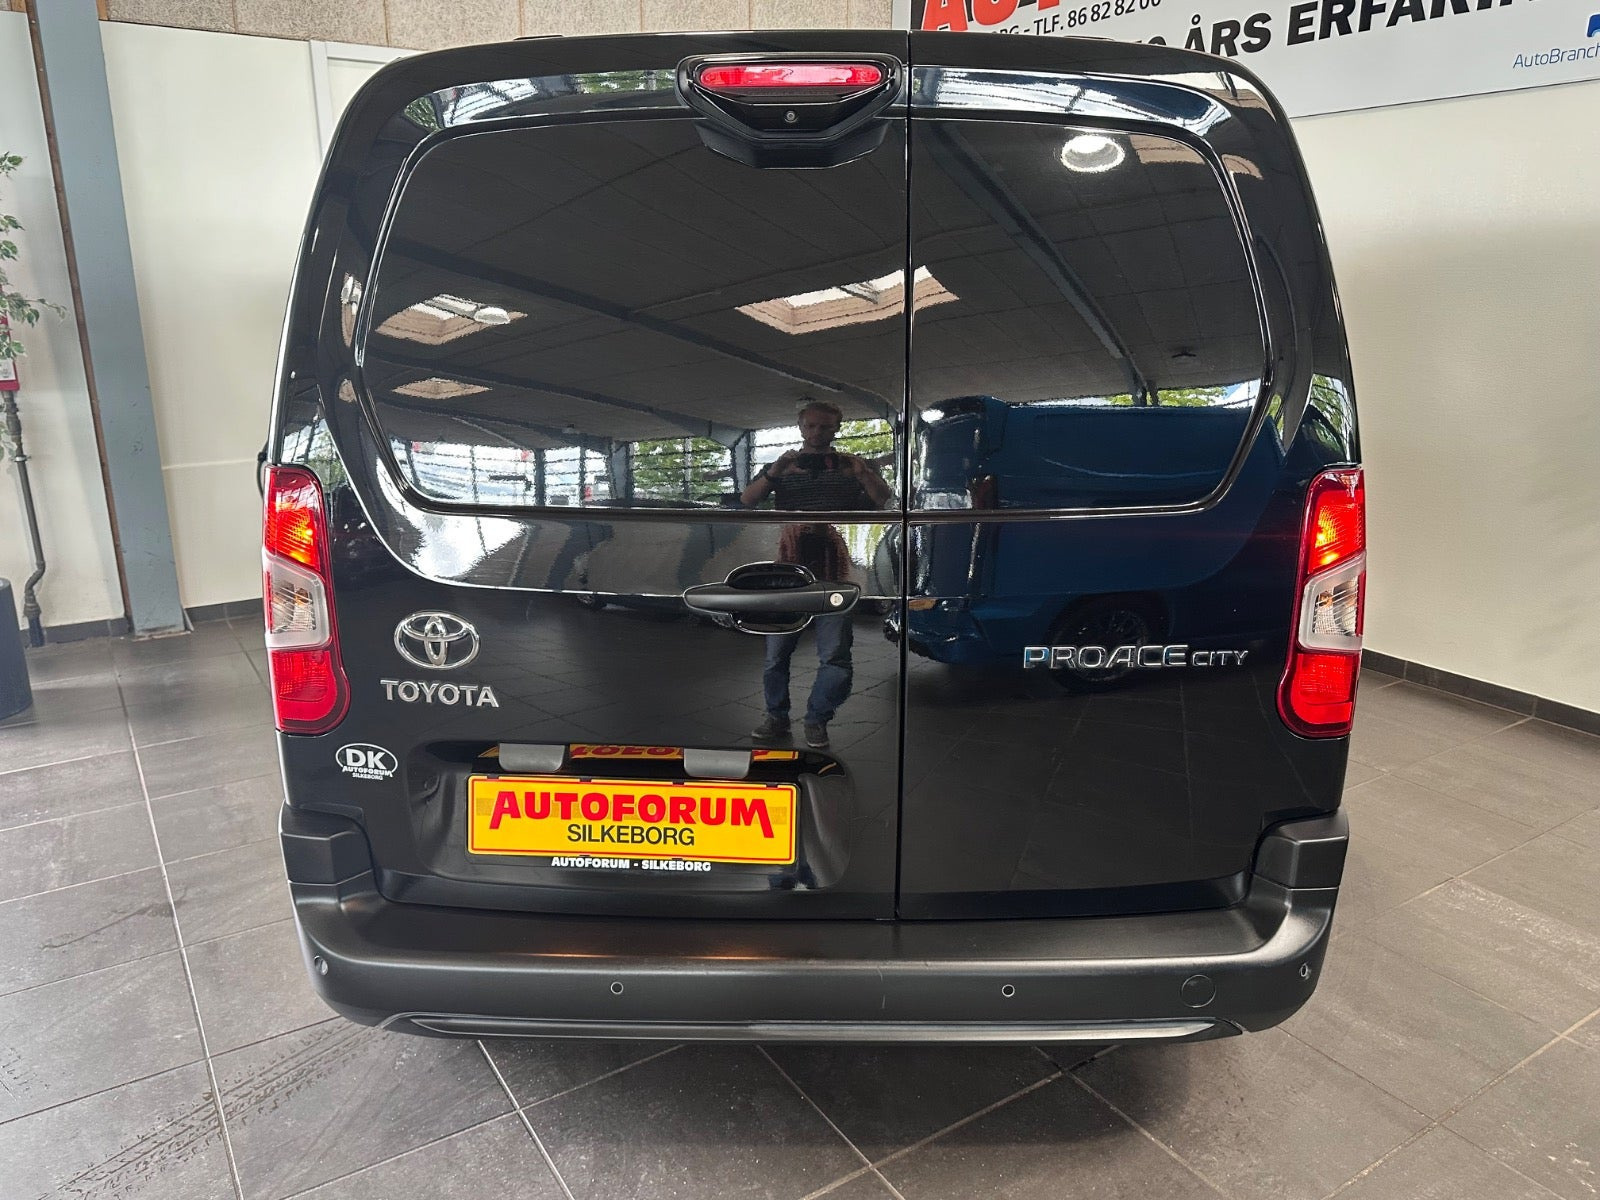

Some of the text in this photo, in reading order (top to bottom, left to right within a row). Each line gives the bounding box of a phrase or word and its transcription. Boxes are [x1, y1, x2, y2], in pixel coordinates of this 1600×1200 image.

[1033, 14, 1064, 36] TLF.
[1067, 7, 1087, 28] 86
[1090, 1, 1111, 22] 82
[1114, 0, 1136, 17] 82
[1184, 12, 1272, 57] ÅRS
[1023, 644, 1249, 669] PROACE CITY
[380, 678, 499, 708] TOYOTA
[345, 748, 387, 770] DK
[342, 765, 393, 778] AUTOFORUM
[352, 772, 383, 780] SILKEBORG
[489, 790, 774, 838] AUTOFORUM
[567, 823, 695, 846] SILKEBORG
[551, 856, 630, 870] AUTOFORUM
[641, 859, 711, 872] SILKEBORG
